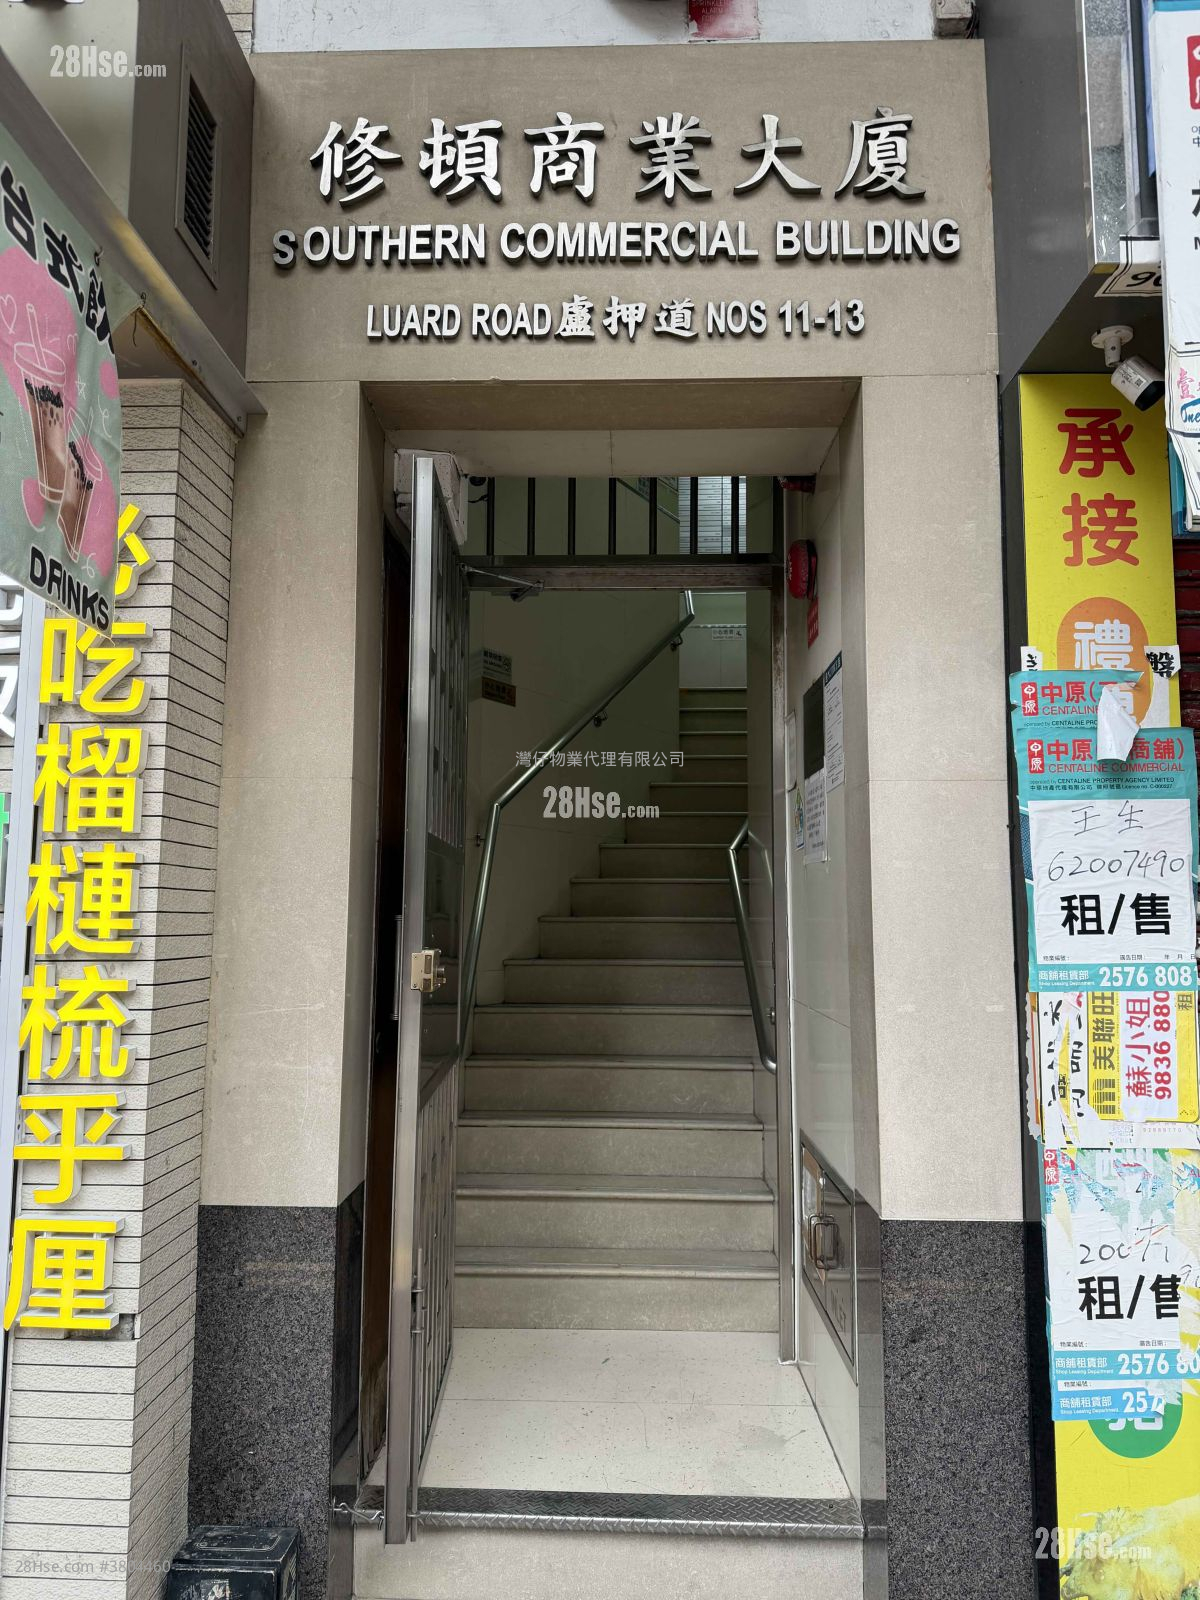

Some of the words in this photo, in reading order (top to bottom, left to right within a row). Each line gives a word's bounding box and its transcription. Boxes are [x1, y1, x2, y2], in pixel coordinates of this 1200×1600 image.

[310, 107, 927, 204] 修頓商業大廈
[272, 222, 486, 268] SOUTHERN
[499, 221, 759, 263] COMMERCIAL
[776, 218, 961, 261] BUILDING
[366, 303, 462, 340] LUARD
[471, 302, 552, 339] ROAD
[554, 294, 700, 341] 盧押道
[706, 300, 767, 338] NOS
[778, 299, 866, 336] 11-13
[1057, 408, 1140, 567] 承接
[30, 546, 110, 632] DRINKS
[1041, 681, 1118, 705] 中原(
[1042, 706, 1099, 717] CENTALIN
[1048, 763, 1108, 774] CENTALINE
[1111, 762, 1185, 773] COMMERCIAL
[1048, 850, 1185, 881] 62007490
[1060, 892, 1171, 936] 租/售
[1099, 967, 1149, 987] 2576
[1154, 965, 1197, 987] 808
[1125, 997, 1153, 1098] 蘇小姐
[1153, 1041, 1172, 1100] 9836
[1077, 1274, 1182, 1320] 租/售
[1117, 1353, 1170, 1375] 2576
